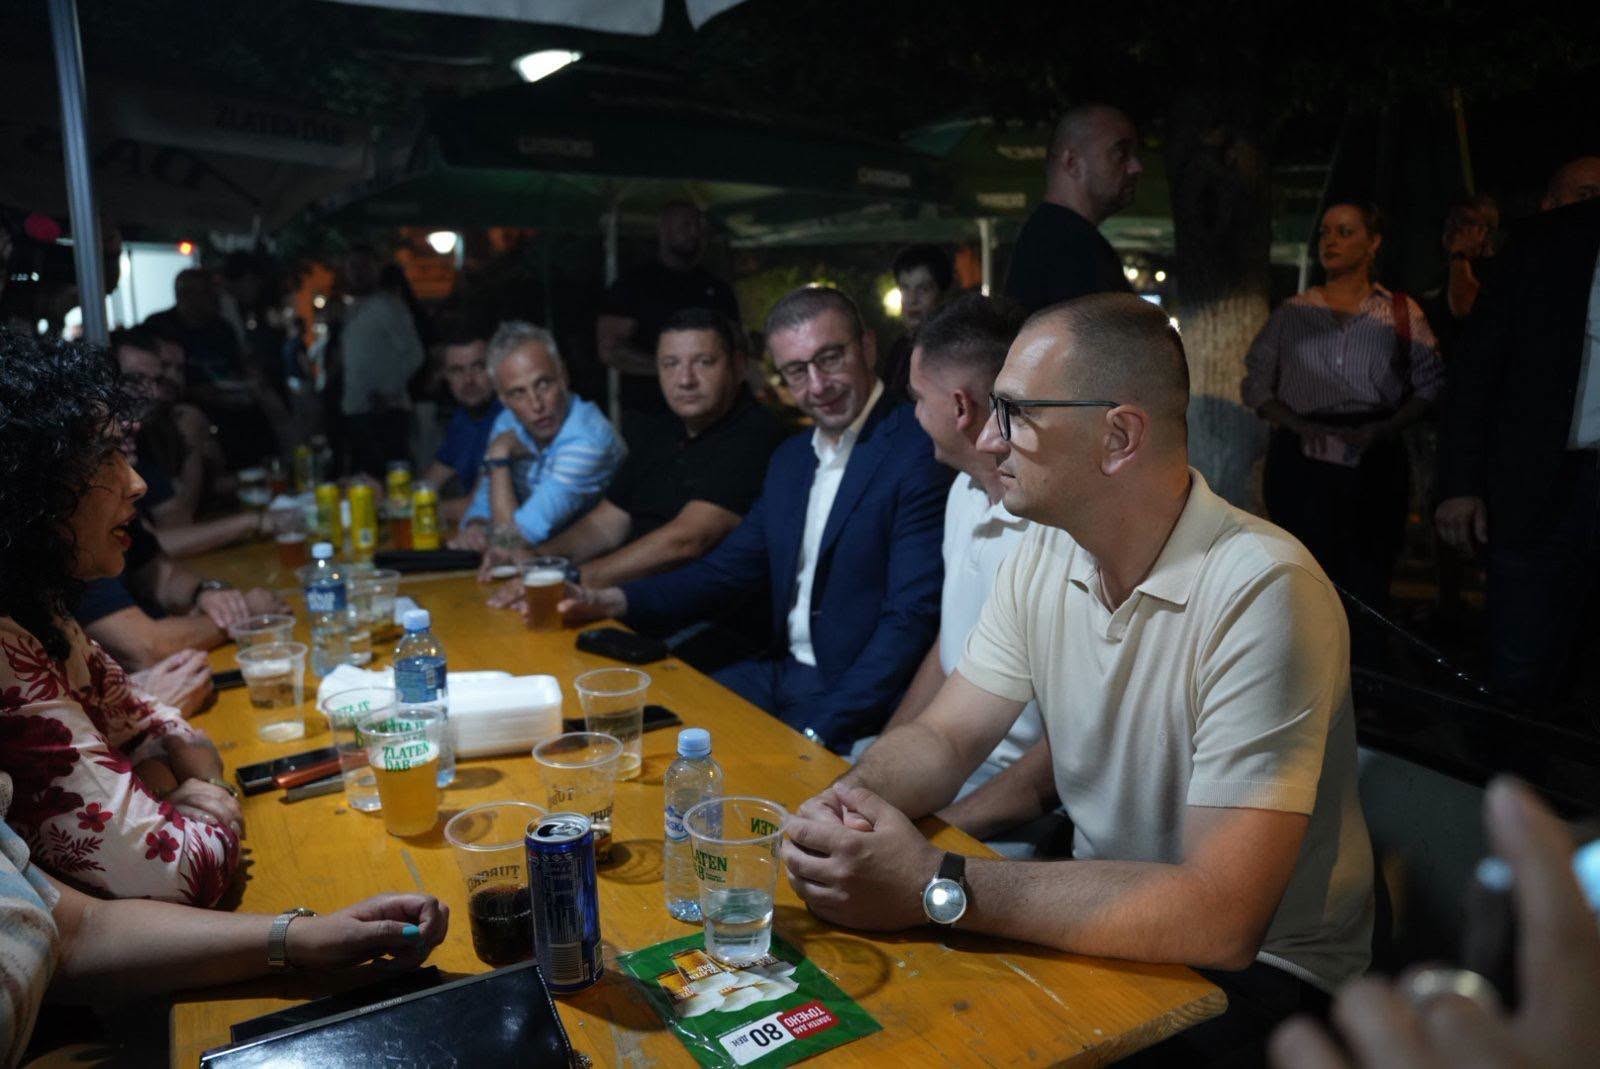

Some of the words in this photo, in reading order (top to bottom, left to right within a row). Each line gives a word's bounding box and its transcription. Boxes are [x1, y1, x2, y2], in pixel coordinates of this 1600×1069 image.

[383, 742, 429, 760] ZLATEN
[385, 759, 410, 773] DAB
[783, 1006, 825, 1028] ТОЧЕНО
[807, 1014, 832, 1031] ЗЛАТЕН
[749, 1022, 784, 1047] 80
[793, 1023, 808, 1035] ДАБ
